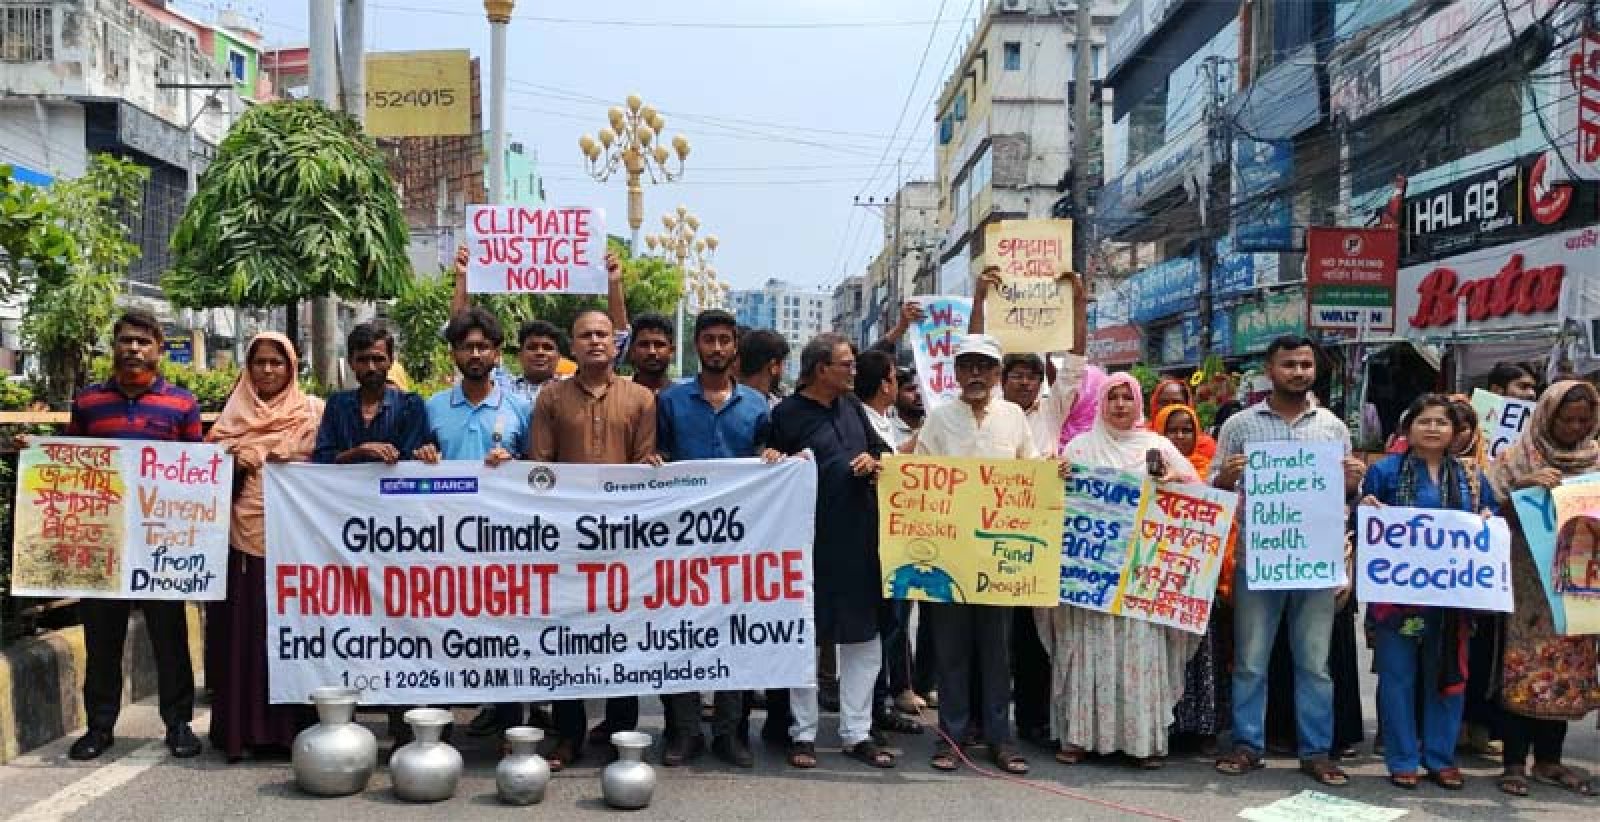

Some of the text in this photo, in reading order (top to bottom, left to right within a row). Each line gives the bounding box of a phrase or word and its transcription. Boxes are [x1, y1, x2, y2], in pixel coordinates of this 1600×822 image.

[473, 207, 591, 237] CLIMATE
[1415, 180, 1498, 236] HALAB
[478, 237, 589, 266] JUSTICE
[1320, 258, 1384, 268] NO PARKING
[1408, 253, 1566, 328] Bata
[1320, 311, 1383, 324] WALTN
[139, 446, 224, 484] Protect
[1249, 449, 1316, 470] Climate
[604, 481, 646, 493] Green
[900, 463, 969, 495] STOP
[1248, 471, 1327, 497] Justice is
[1252, 502, 1302, 525] Public
[141, 522, 197, 547] Tract
[342, 506, 745, 553] Global Climate Strike 2026
[1251, 527, 1308, 550] Health
[1366, 513, 1491, 552] Defund
[151, 546, 206, 572] from
[992, 541, 1035, 563] Fund
[130, 568, 216, 594] Drought
[1249, 554, 1336, 583] Justice!
[276, 549, 806, 618] FROM DROUGHT TO JUSTICE
[279, 613, 806, 660] End Carbon Game, Climate Justice Now!
[396, 671, 440, 688] 2026
[459, 669, 480, 688] 10
[484, 668, 508, 688] AM
[613, 657, 730, 689] Bangladesh
